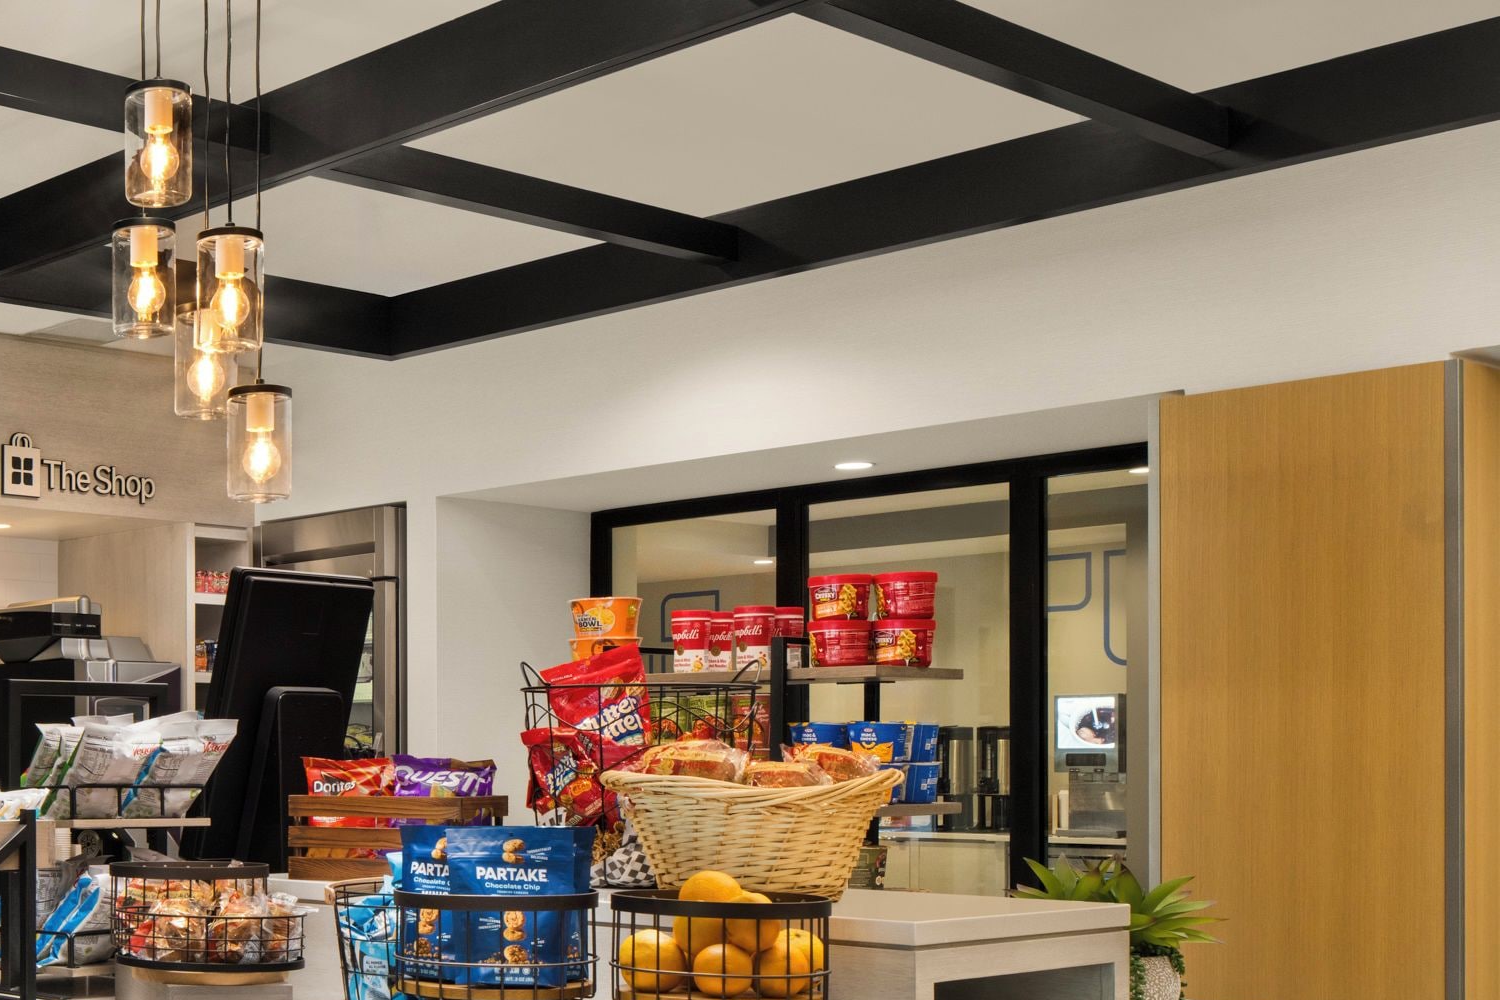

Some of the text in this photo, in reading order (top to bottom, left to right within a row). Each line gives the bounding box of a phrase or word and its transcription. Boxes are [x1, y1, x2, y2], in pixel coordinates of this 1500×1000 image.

[41, 458, 157, 504] The Shop
[313, 780, 357, 793] Doritos
[394, 765, 479, 793] QUEST
[410, 861, 449, 877] PARTA
[475, 866, 549, 882] PARTAKE
[484, 881, 541, 892] Chocolate Chip
